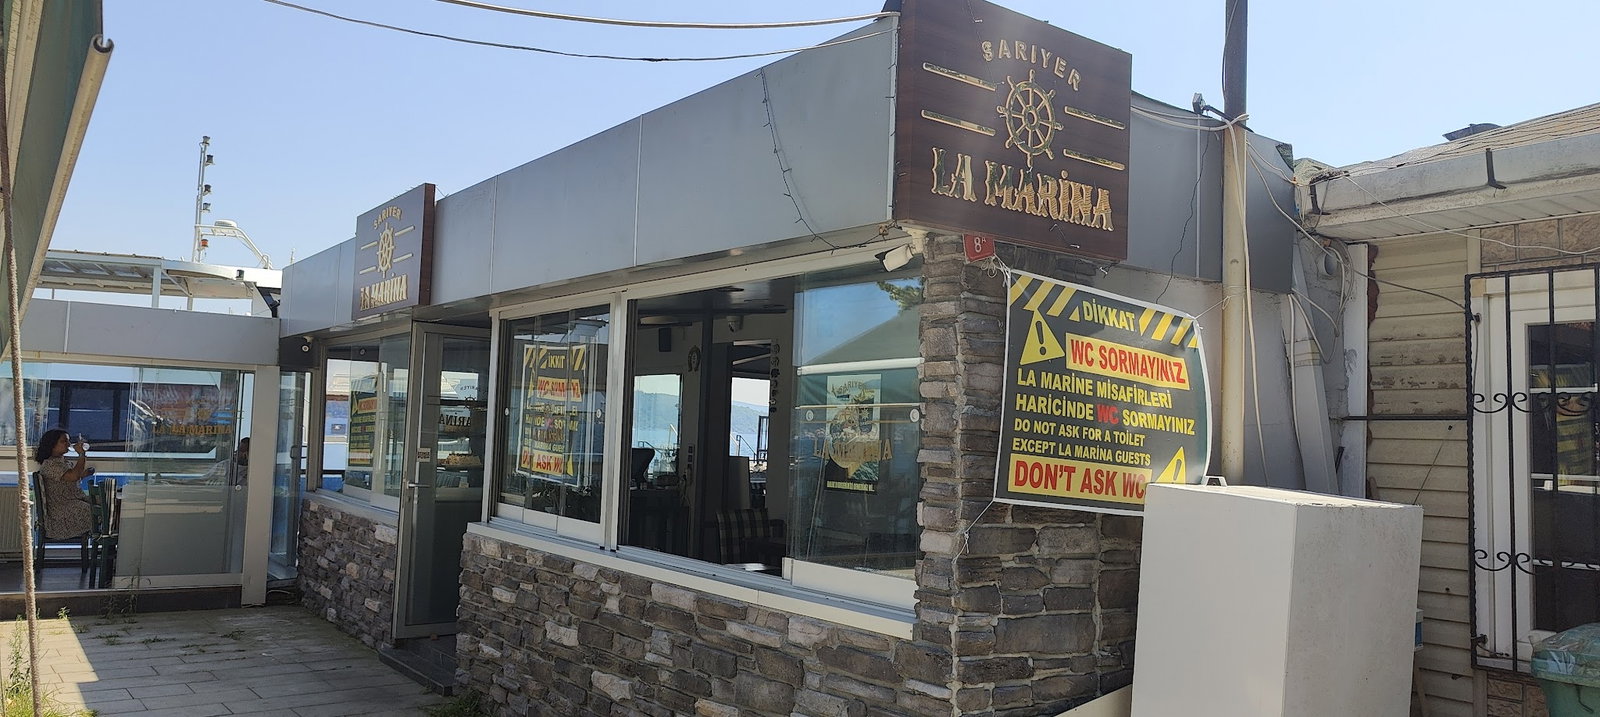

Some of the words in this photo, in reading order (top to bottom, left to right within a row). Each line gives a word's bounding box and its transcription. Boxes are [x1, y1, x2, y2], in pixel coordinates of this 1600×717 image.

[982, 39, 1081, 91] SARIYER
[932, 147, 977, 202] LA
[360, 286, 370, 311] LA
[1082, 298, 1136, 333] DİKKAT
[1070, 339, 1095, 367] WC
[1098, 345, 1187, 384] SORMAYINIZ
[1017, 367, 1036, 388] LA
[1040, 371, 1094, 397] MARİNE
[1096, 379, 1173, 409] MİSAFİRLERİ
[1014, 418, 1031, 433] DO
[1033, 420, 1056, 436] NOT
[1058, 424, 1080, 439] ASK
[1082, 426, 1102, 441] FOR
[1104, 430, 1112, 443] A
[1113, 430, 1146, 447] TOİLET
[1015, 393, 1094, 421] HARİCİNDE
[1096, 404, 1119, 425] WC
[1122, 409, 1196, 436] SORMAYINIZ
[1012, 437, 1056, 455] EXCEPT
[1058, 443, 1072, 457] LA
[1074, 445, 1113, 462] MARİNA
[1115, 450, 1151, 467] GUESTS
[1014, 460, 1077, 492] DON'T
[1079, 467, 1119, 497] ASK
[1122, 472, 1146, 499] WC
